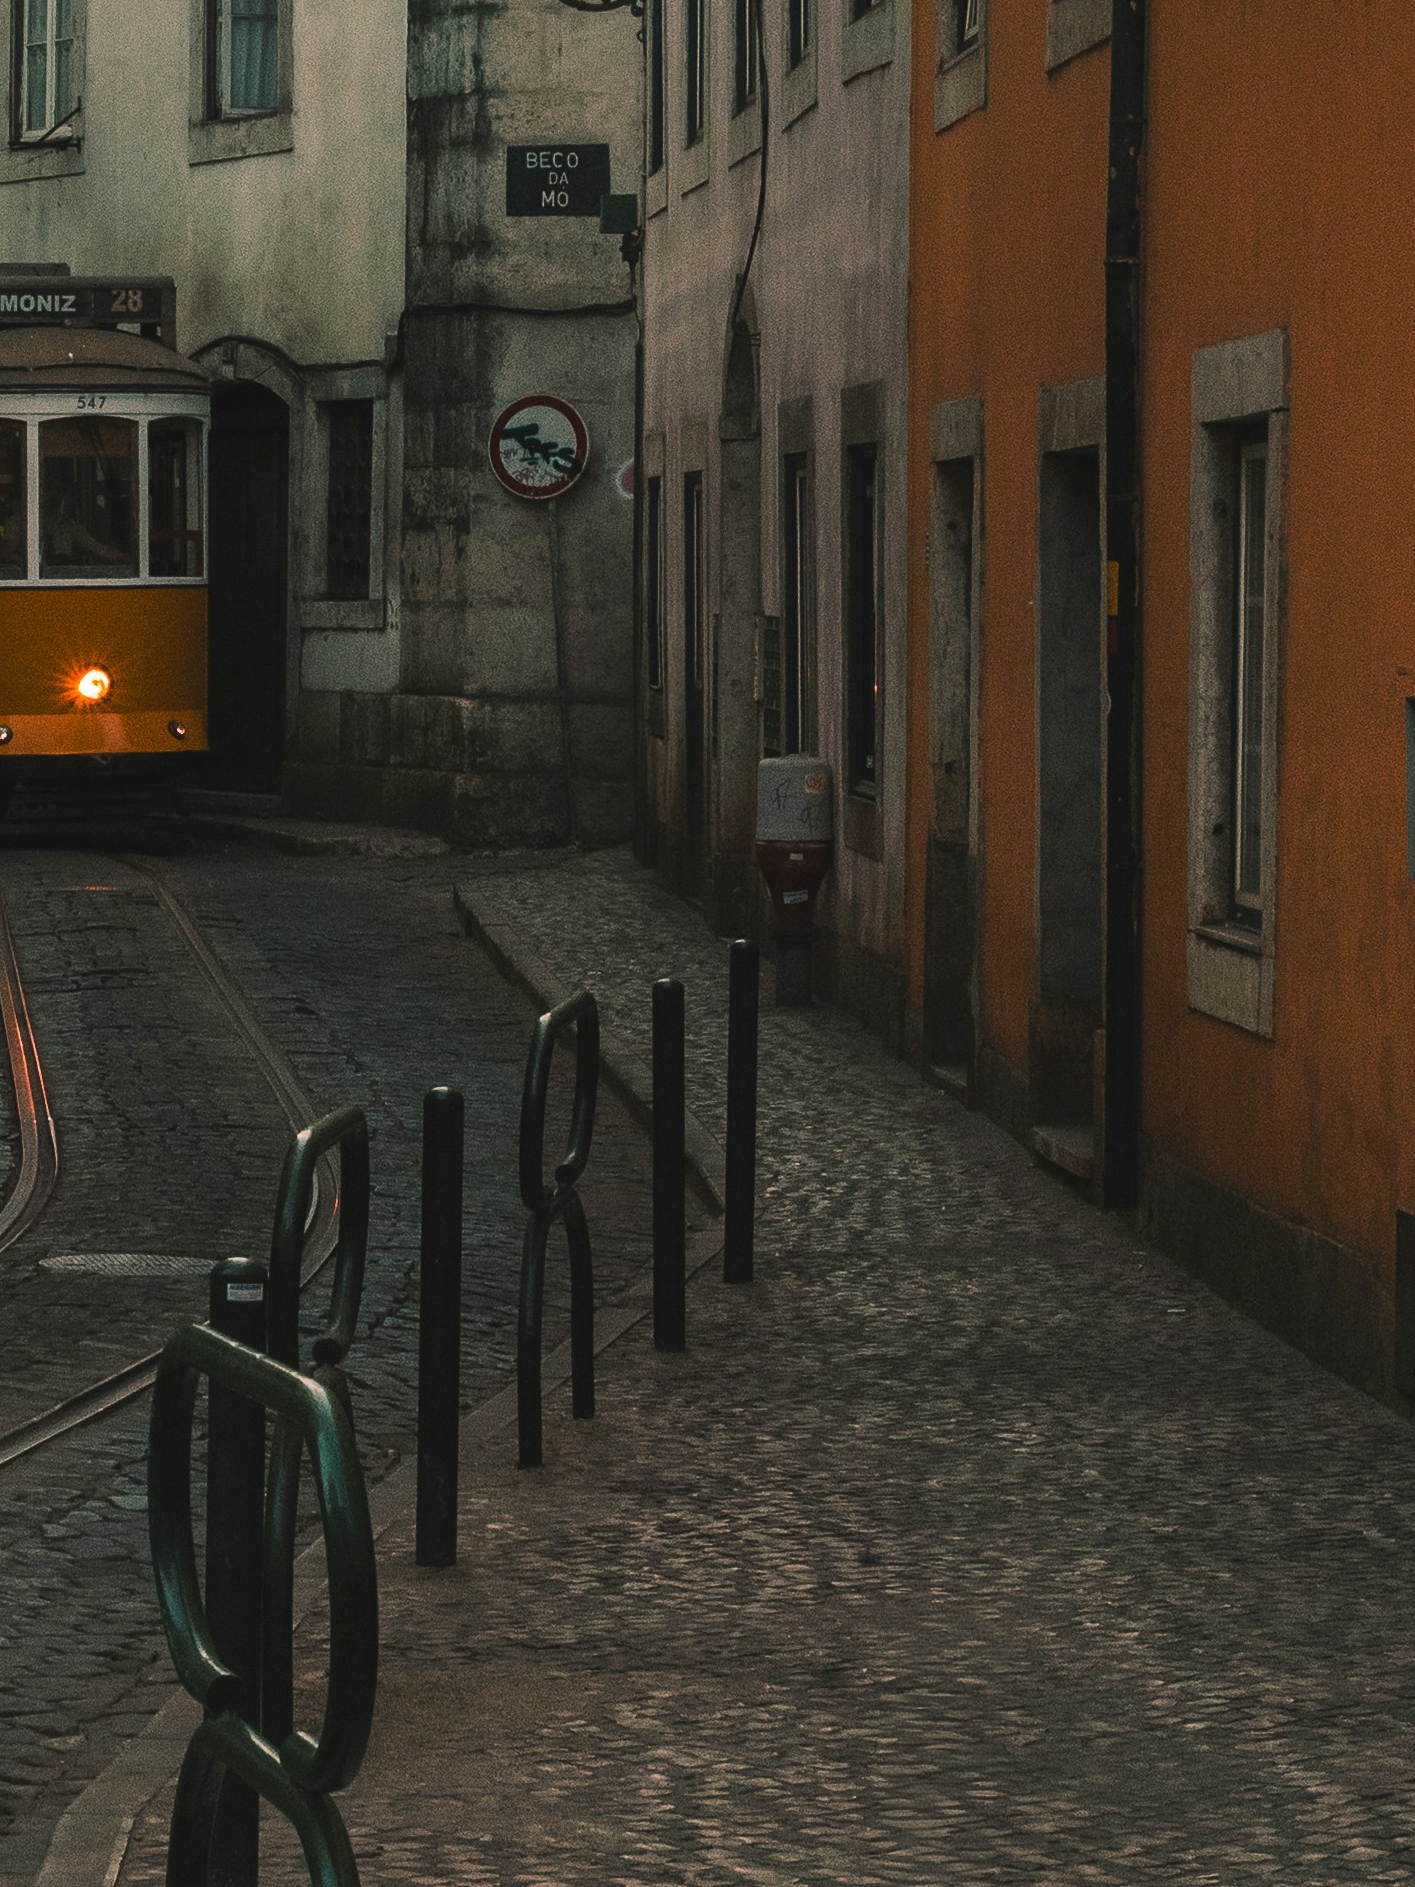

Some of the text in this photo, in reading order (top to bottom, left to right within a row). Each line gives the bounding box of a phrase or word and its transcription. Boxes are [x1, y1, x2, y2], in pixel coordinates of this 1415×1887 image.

[525, 151, 579, 169] BECO
[548, 171, 569, 185] DA
[0, 294, 77, 312] MONIZ
[110, 289, 143, 312] 28
[77, 396, 107, 409] 547
